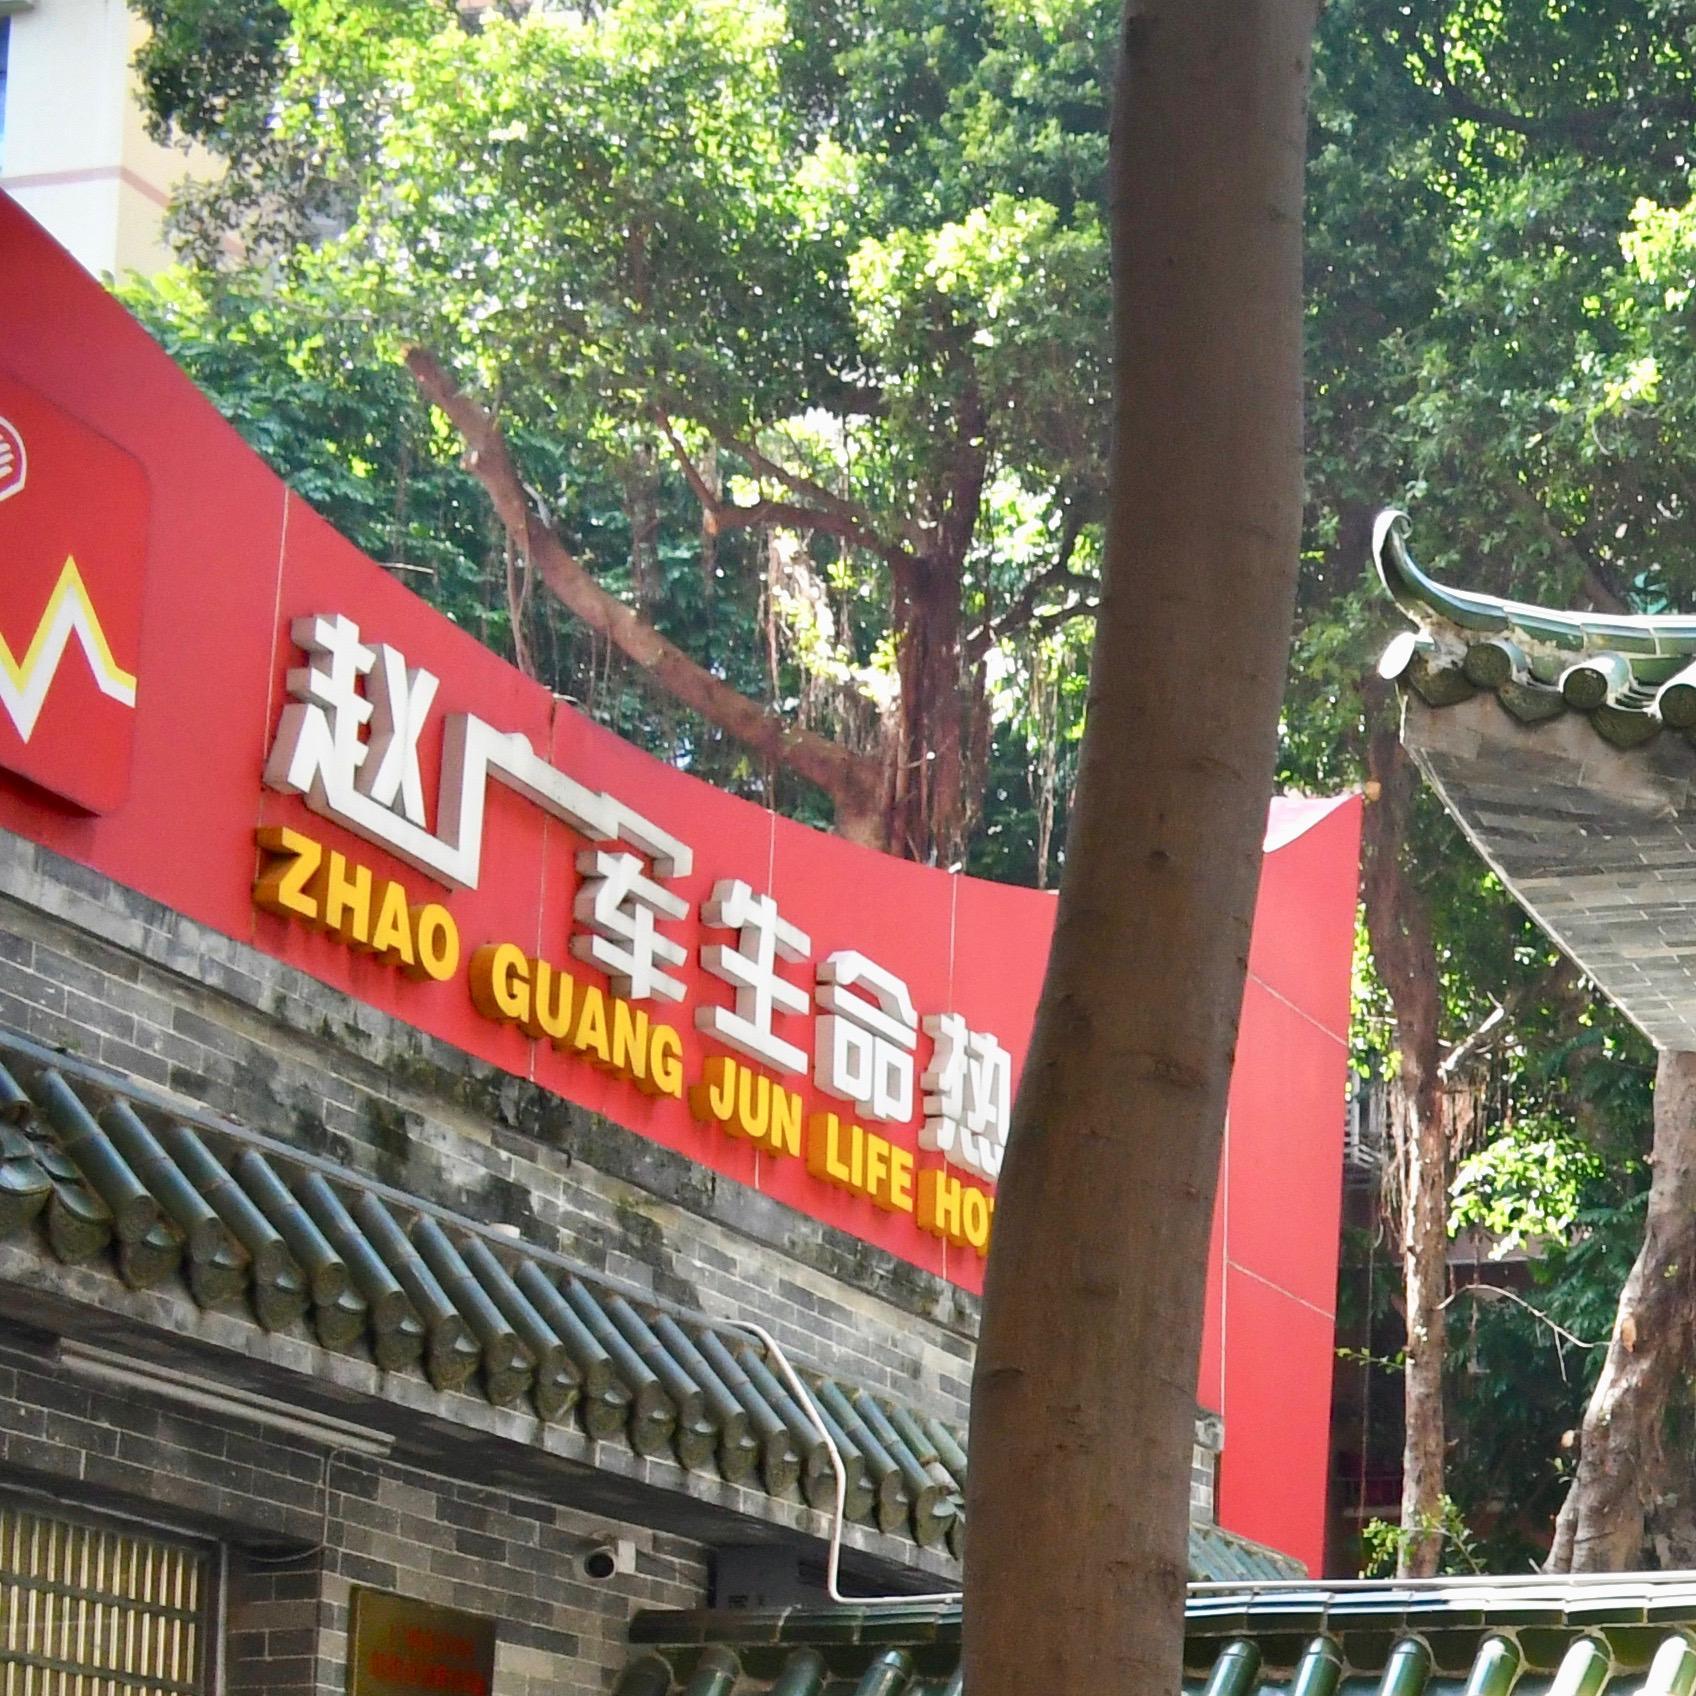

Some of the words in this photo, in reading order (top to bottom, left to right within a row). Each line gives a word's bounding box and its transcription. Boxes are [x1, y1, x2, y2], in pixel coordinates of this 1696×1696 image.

[254, 825, 460, 981] ZHAO
[472, 943, 683, 1099] GUANG
[695, 1055, 803, 1158] JUN
[810, 1111, 914, 1214] LIFE
[920, 1168, 995, 1250] HO
